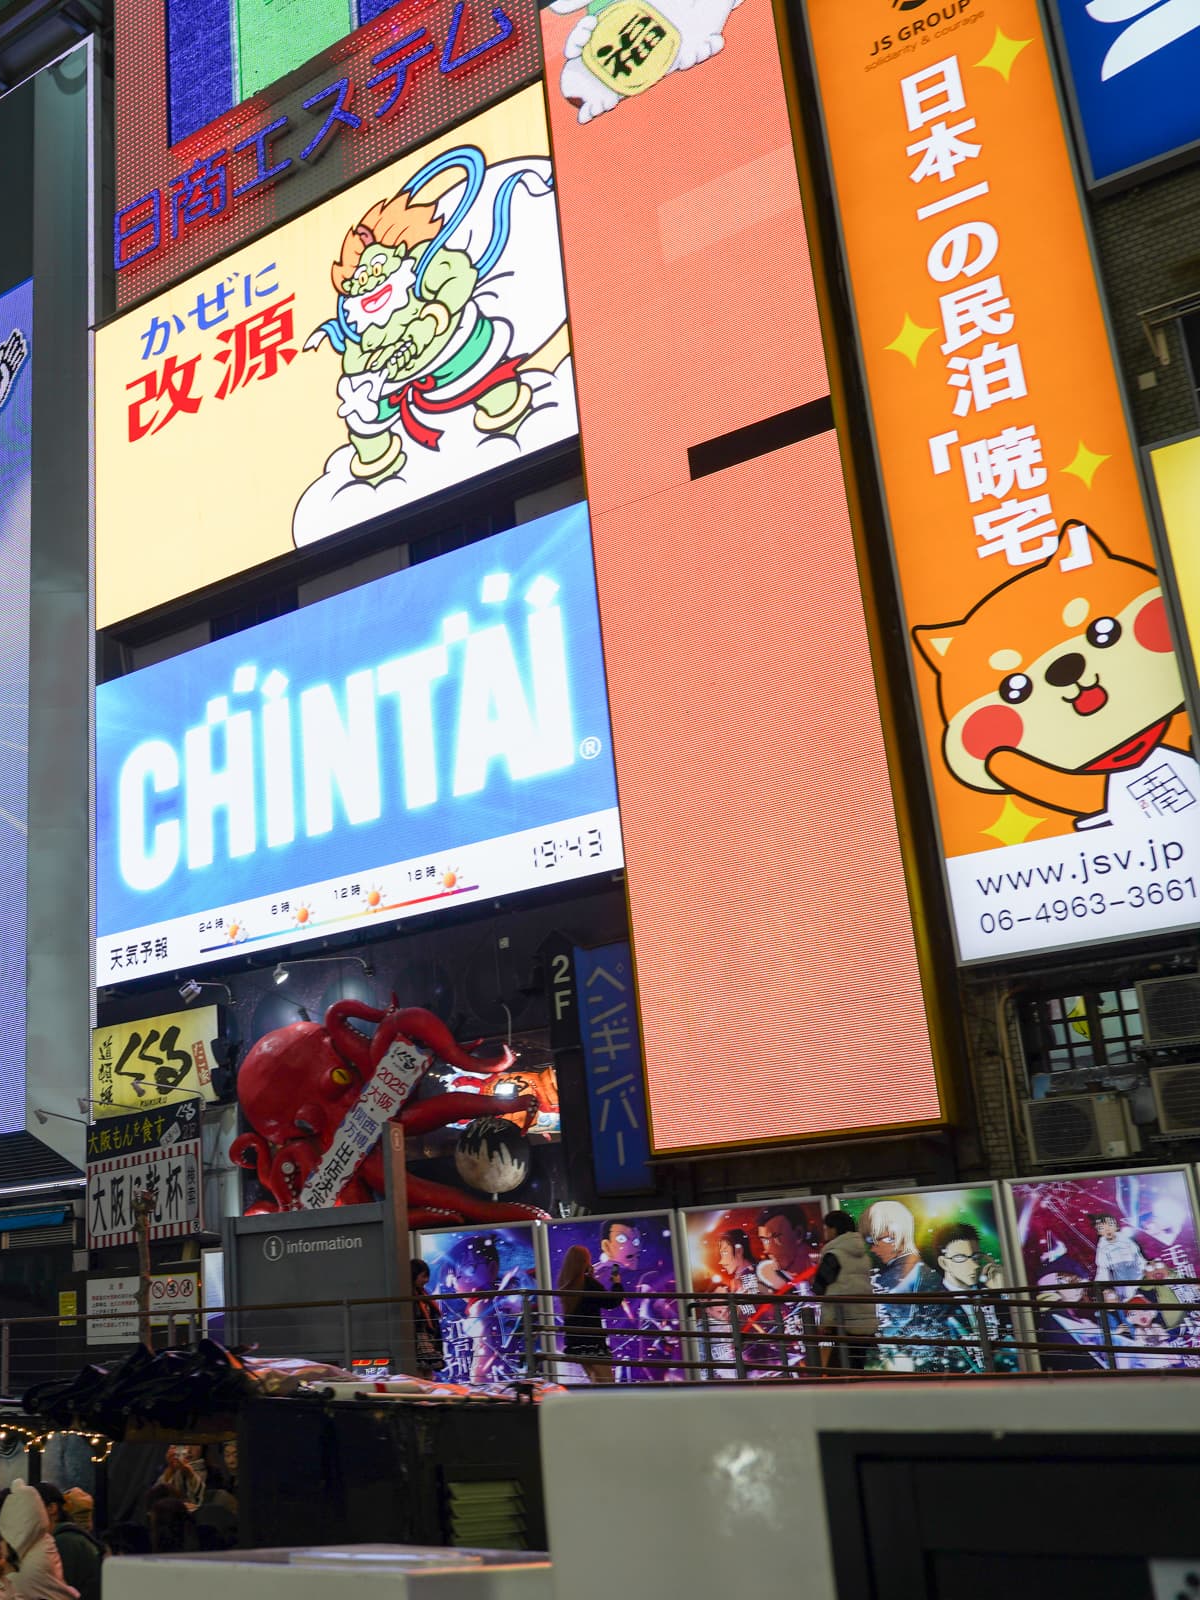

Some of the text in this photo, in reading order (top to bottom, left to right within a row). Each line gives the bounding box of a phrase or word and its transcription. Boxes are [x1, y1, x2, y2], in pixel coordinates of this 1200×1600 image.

[596, 13, 667, 80] 福
[870, 0, 971, 57] JS GROUP
[114, 2, 514, 270] 日商エステム
[141, 262, 279, 360] かぜに
[126, 292, 298, 443] 改源
[118, 572, 576, 893] CHINTAI
[533, 829, 603, 869] 19:43
[976, 838, 1184, 897] www.jsv.jp
[979, 876, 1198, 935] 06-4963-3661
[110, 936, 168, 971] 天気予報
[114, 1025, 193, 1095] くくる
[377, 1066, 410, 1097] 2025
[586, 963, 639, 1167] ペンギンバー
[352, 1106, 380, 1137] 関西
[368, 1085, 396, 1113] 大阪
[88, 1114, 166, 1155] 大阪もんを食す
[344, 1121, 369, 1149] 万博
[287, 1234, 362, 1254] information
